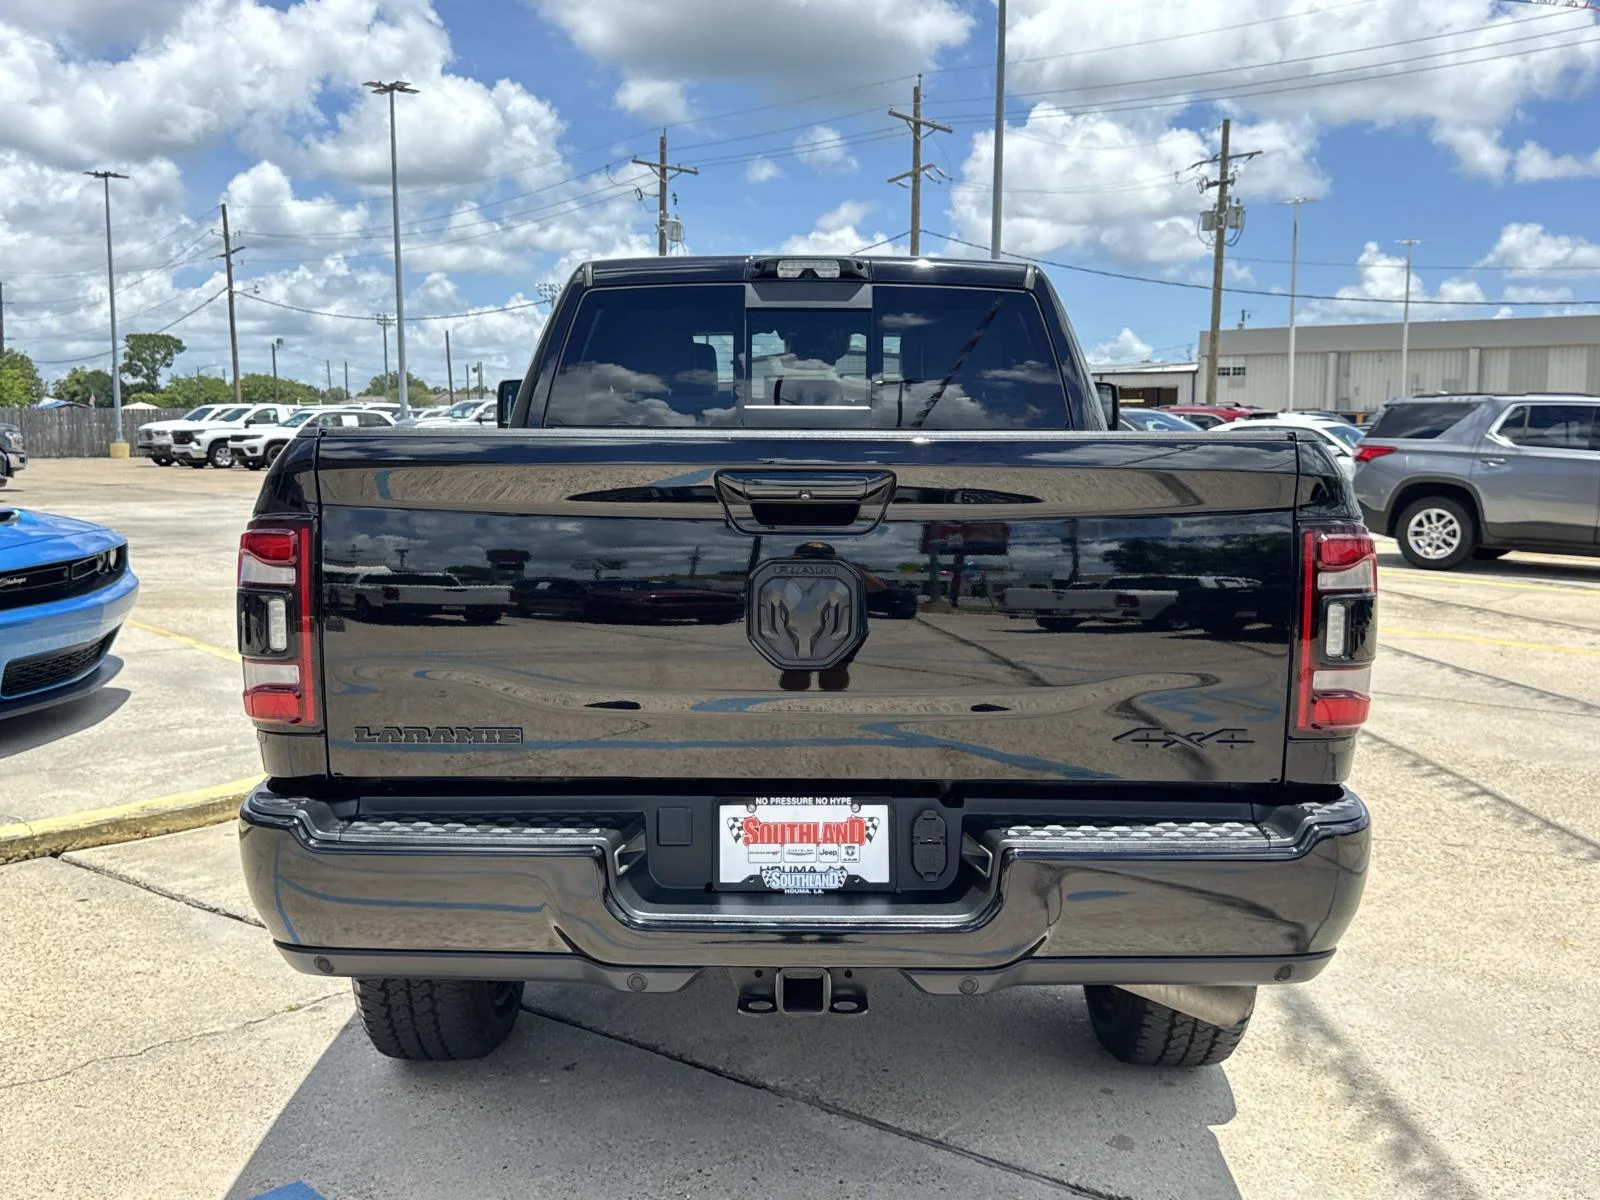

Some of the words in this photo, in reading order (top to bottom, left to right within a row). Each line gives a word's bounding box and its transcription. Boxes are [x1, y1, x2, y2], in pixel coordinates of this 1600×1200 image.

[774, 565, 837, 577] RAM
[352, 725, 524, 745] LARAMIE
[755, 797, 768, 805] NO
[770, 797, 813, 805] PRESSURE
[816, 797, 828, 805] NO
[830, 797, 852, 805] HYPE
[742, 817, 866, 846] SOUTHLAND
[819, 849, 838, 857] Jeep
[770, 870, 839, 888] SOUTHLAND
